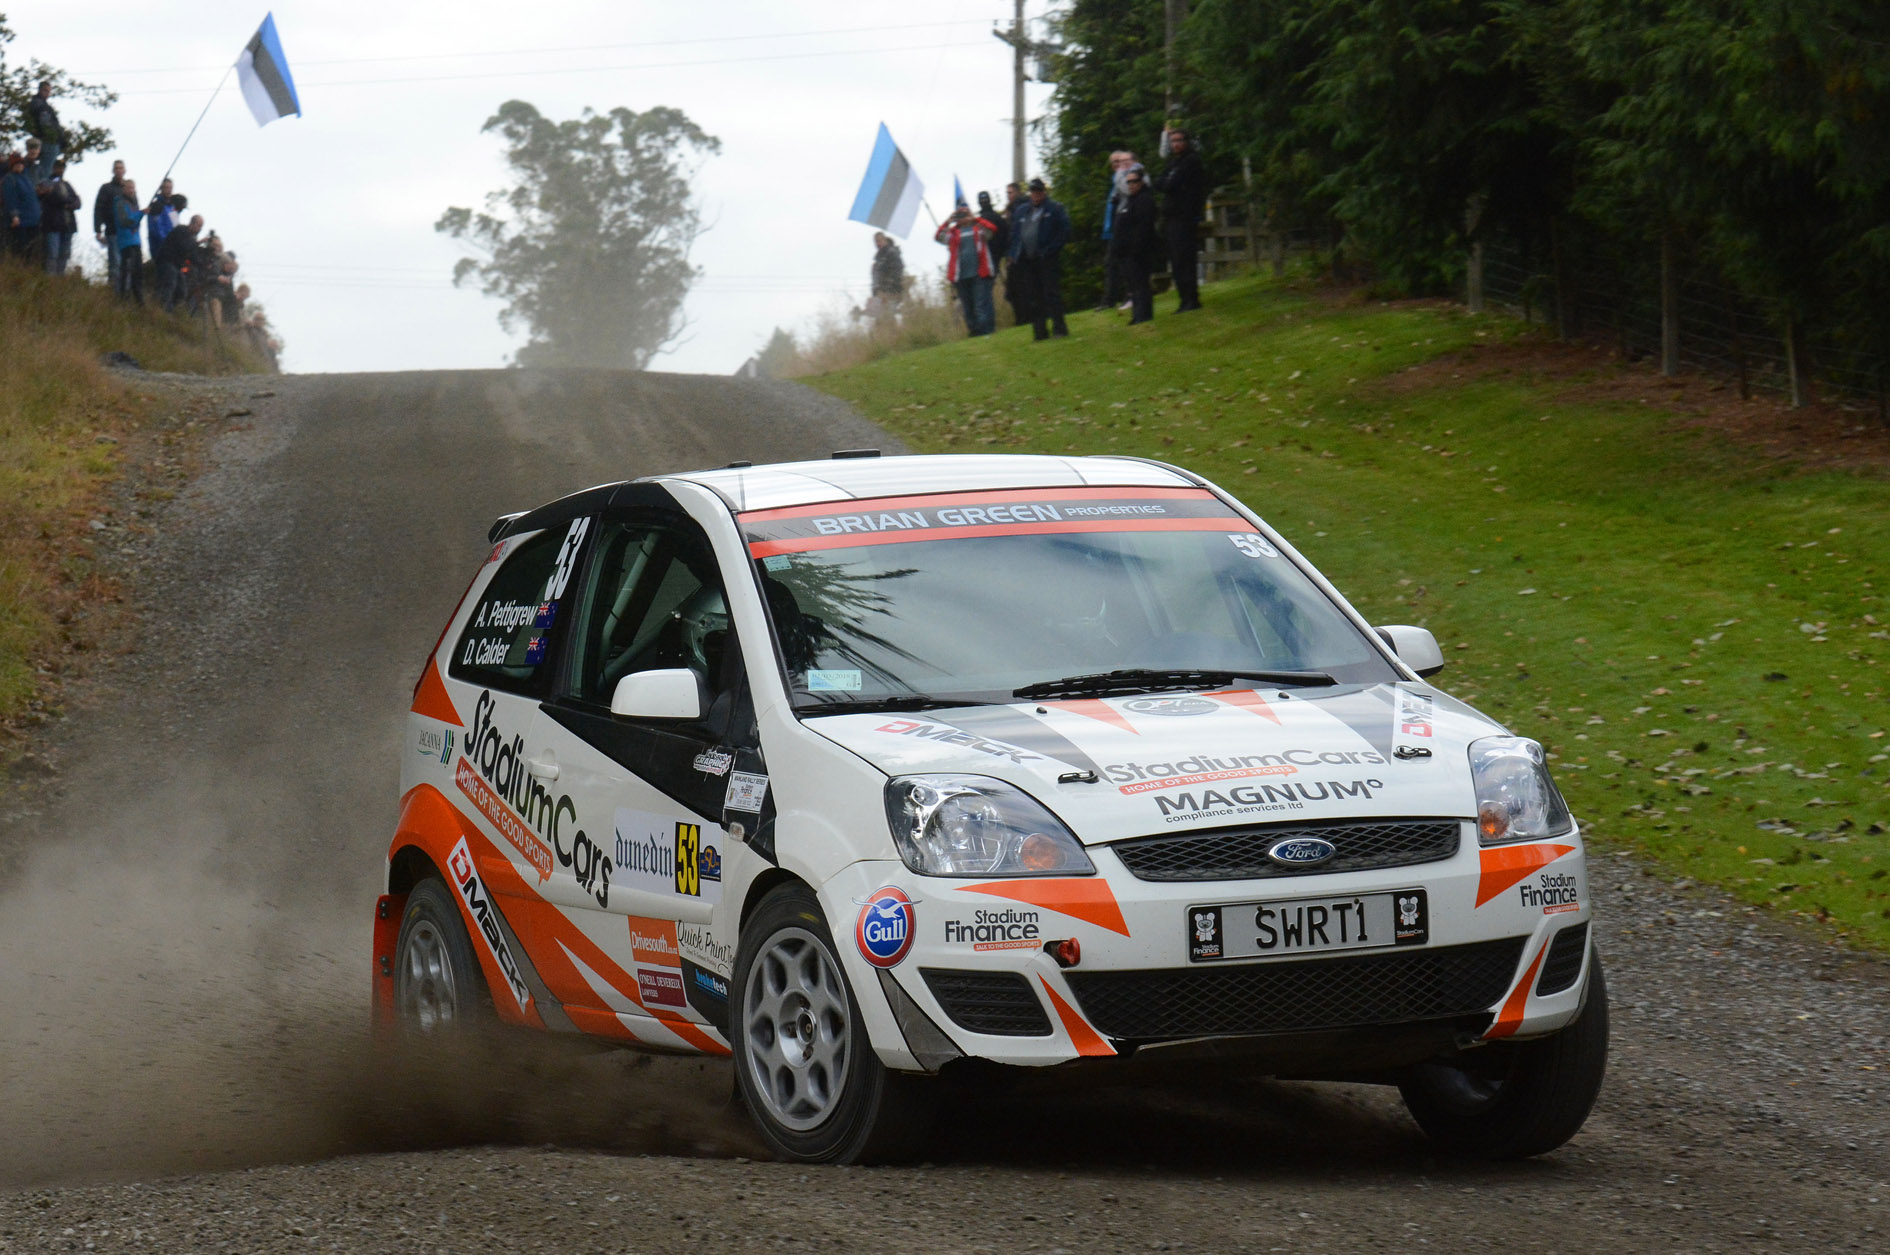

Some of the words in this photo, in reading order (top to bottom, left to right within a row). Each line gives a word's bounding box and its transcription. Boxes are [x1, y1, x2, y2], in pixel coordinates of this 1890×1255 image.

[812, 510, 930, 535] BRIAN
[936, 504, 1063, 526] GREEN
[1066, 504, 1166, 517] PROPERTIES
[544, 516, 591, 601] 53
[1227, 534, 1278, 558] 53
[474, 602, 488, 628] A.
[487, 600, 539, 634] Pettigrew
[462, 638, 475, 665] D.
[475, 637, 511, 665] Calder
[419, 730, 441, 751] JACANNA
[874, 720, 1044, 764] DMACK
[1106, 749, 1385, 783] StadiumCars
[1125, 781, 1156, 793] HOME
[1162, 779, 1177, 788] OF
[1178, 774, 1206, 785] THE
[1207, 770, 1247, 781] GOOD
[1249, 766, 1292, 777] SPORTS
[464, 689, 613, 909] StadiumCars
[1165, 806, 1234, 824] compliance
[1236, 802, 1286, 814] services
[1287, 801, 1304, 810] ltd
[458, 764, 478, 800] HOME
[478, 787, 488, 809] OF
[488, 802, 500, 824] THE
[501, 812, 525, 847] GOOD
[525, 836, 551, 874] SPORTS
[615, 826, 673, 878] dunedin
[677, 824, 698, 896] 53
[1284, 841, 1322, 859] Ford
[1540, 873, 1577, 888] Stadium
[1519, 884, 1577, 907] Finance
[450, 847, 526, 1003] DMACK
[865, 918, 904, 943] Gull
[945, 919, 1040, 943] Finance
[974, 909, 1039, 924] Stadium
[1255, 901, 1368, 949] SWRT1
[677, 919, 703, 951] Quick
[704, 931, 728, 963] Print
[1193, 947, 1220, 955] Finance
